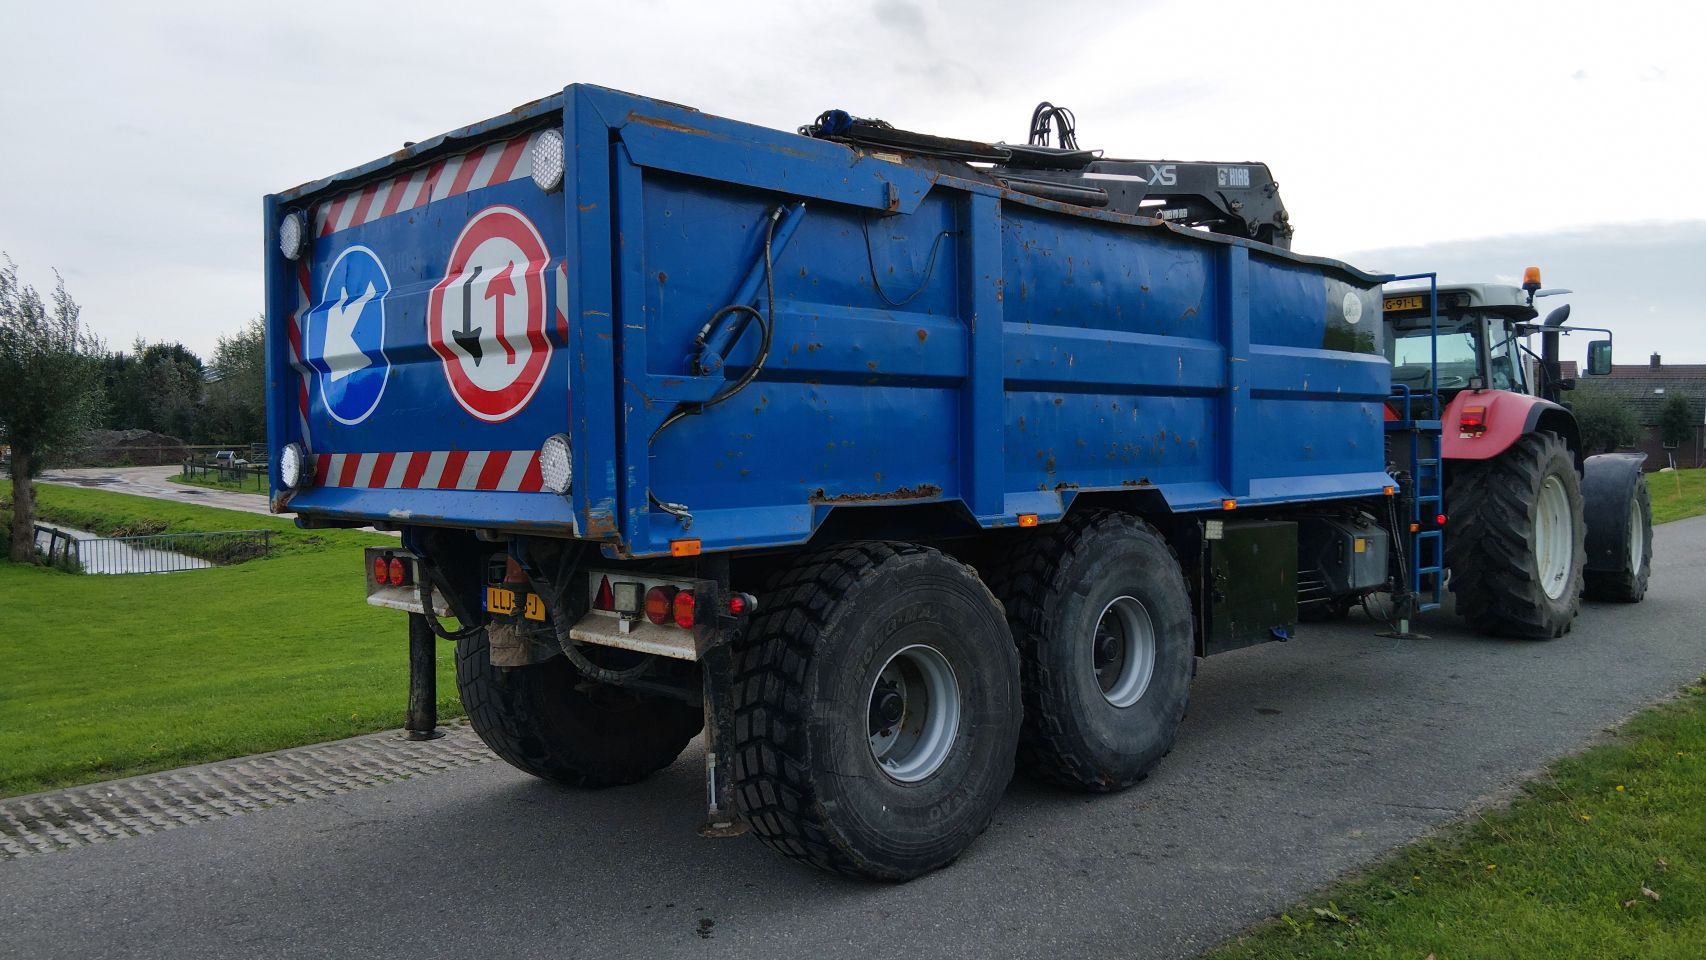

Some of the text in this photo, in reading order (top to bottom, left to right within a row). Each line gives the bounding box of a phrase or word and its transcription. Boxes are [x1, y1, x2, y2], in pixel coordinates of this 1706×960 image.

[1147, 164, 1177, 186] XS
[1229, 167, 1250, 186] HIAB
[1383, 299, 1418, 310] G-91-L
